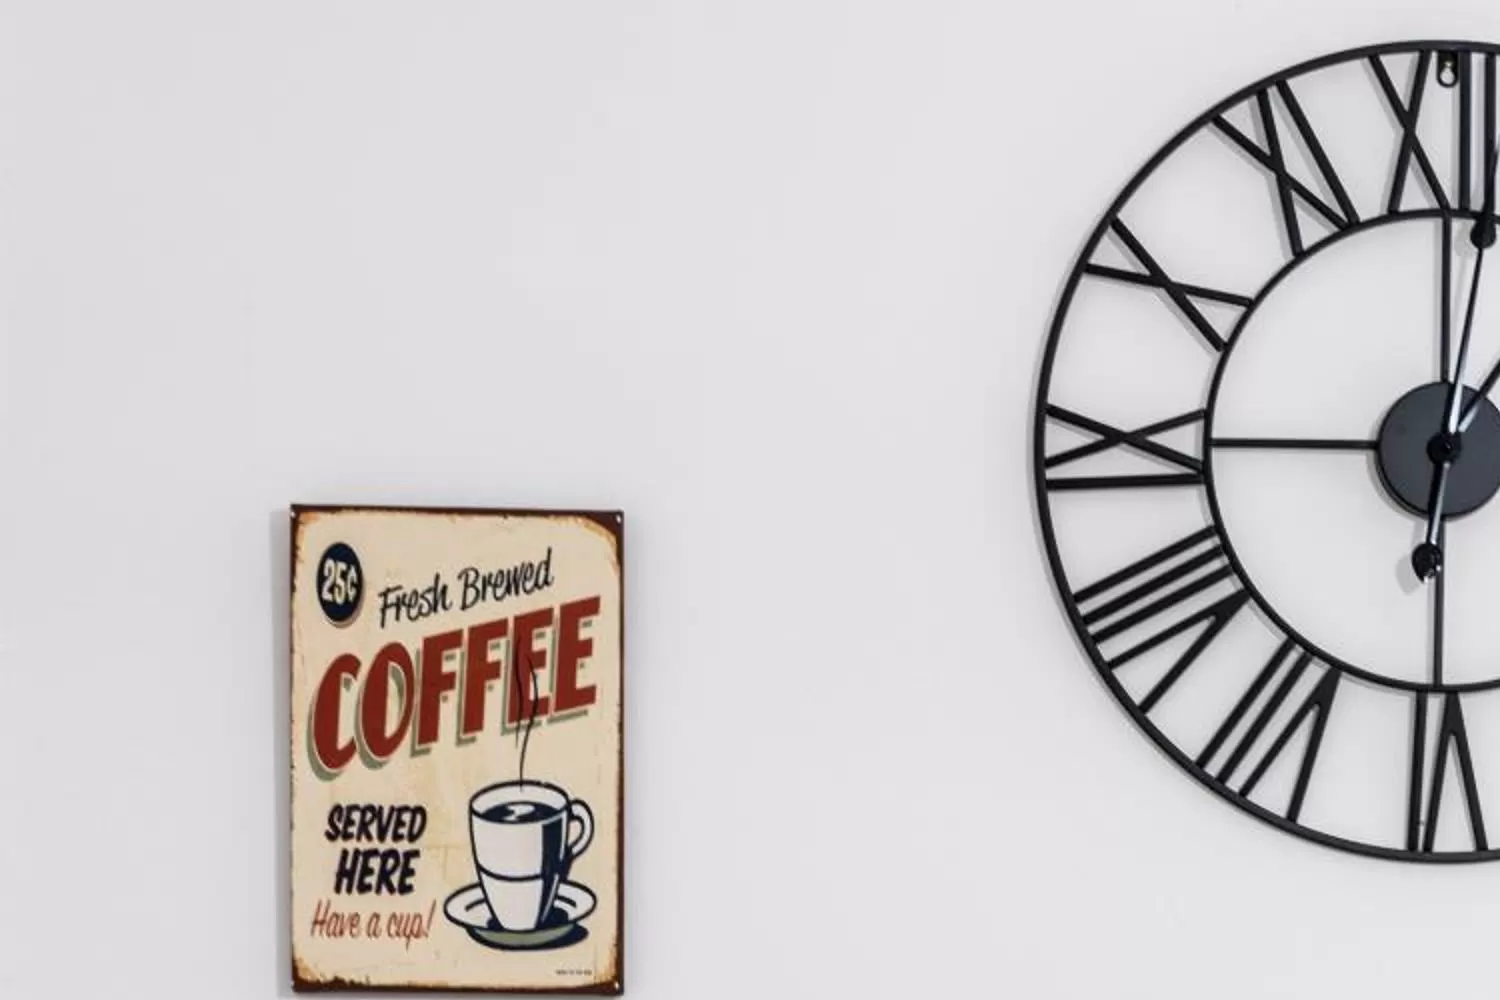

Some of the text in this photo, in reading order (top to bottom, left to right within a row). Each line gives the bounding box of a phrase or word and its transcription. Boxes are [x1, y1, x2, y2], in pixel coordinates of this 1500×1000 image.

[1207, 79, 1360, 258] XI
[1368, 48, 1496, 216] XII
[1083, 213, 1254, 350] X
[1044, 402, 1207, 490] IX
[378, 547, 555, 629] Fresh Brewed
[307, 595, 602, 780] COFFEE
[324, 803, 427, 844] SERVED
[1407, 690, 1489, 853] VI
[310, 899, 437, 952] Have a cup!
[333, 848, 421, 895] HERE
